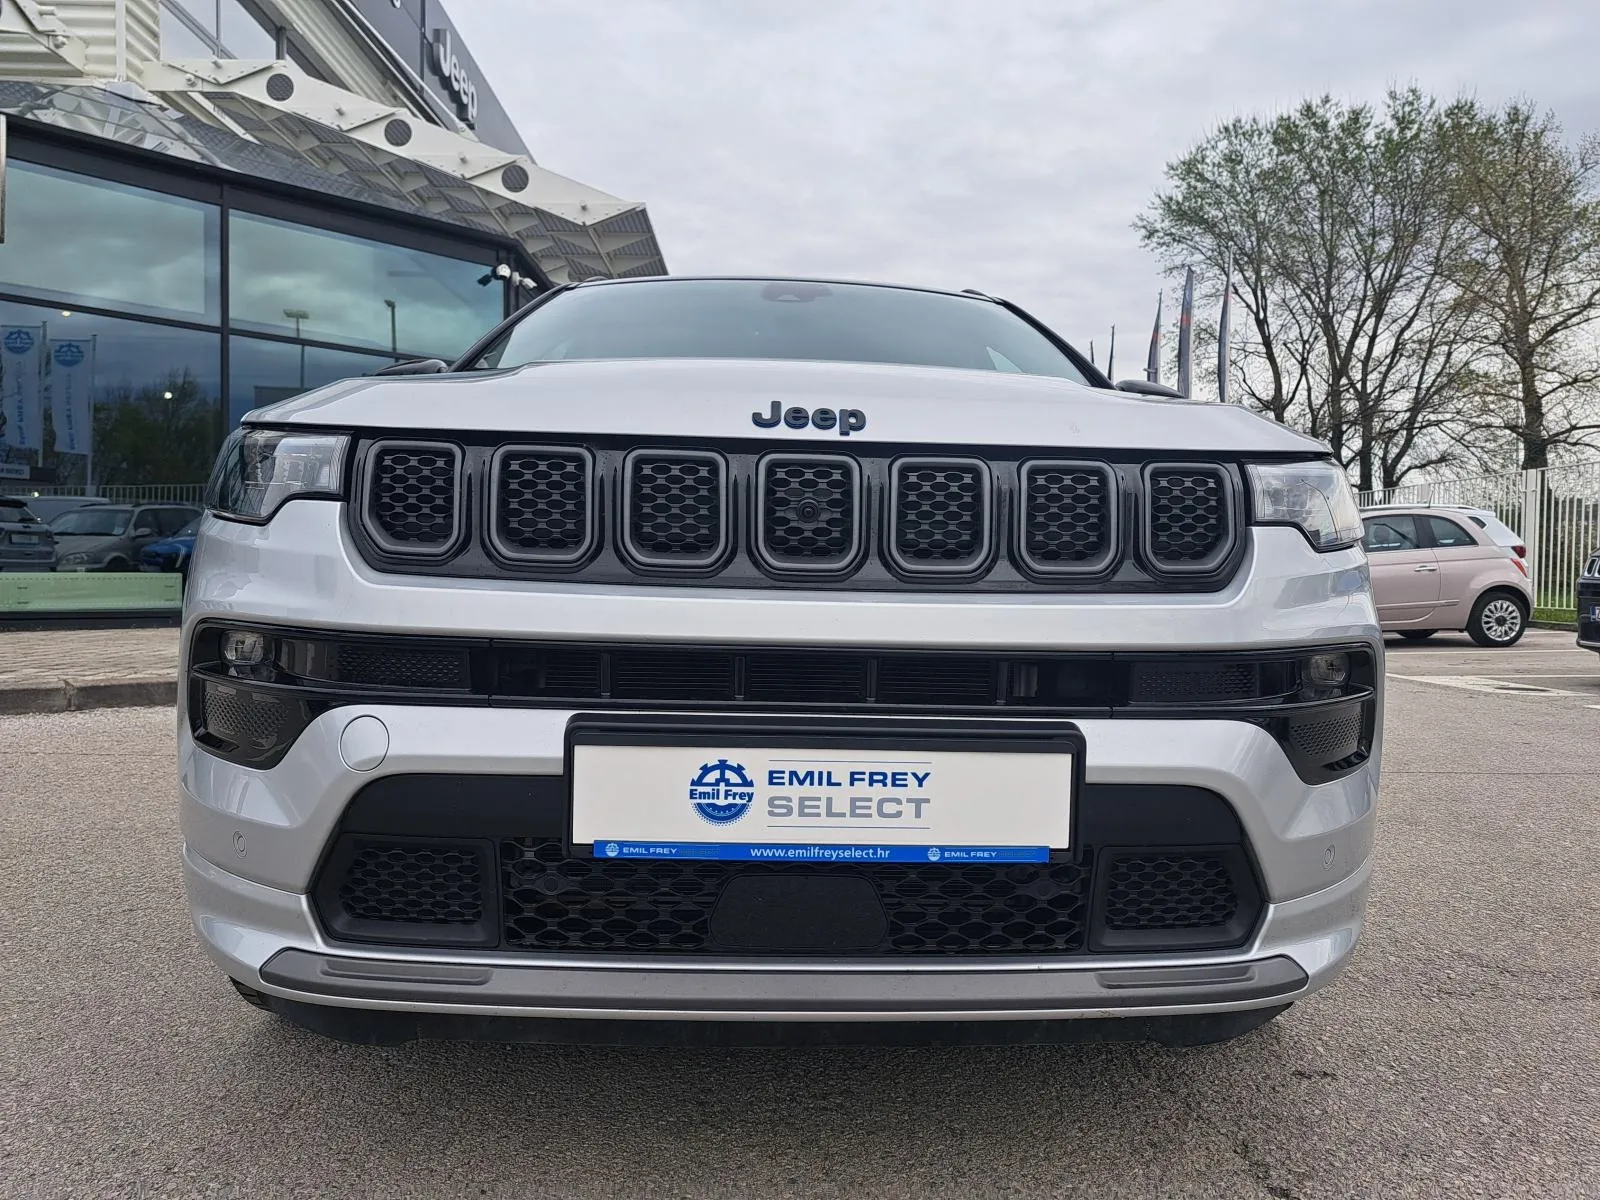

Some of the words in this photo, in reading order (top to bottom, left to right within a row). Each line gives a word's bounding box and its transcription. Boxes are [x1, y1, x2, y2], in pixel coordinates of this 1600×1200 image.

[431, 28, 477, 123] Jeep
[752, 400, 866, 436] Jeep
[767, 769, 842, 787] EMIL
[849, 771, 931, 788] FREY
[689, 788, 720, 801] Emil
[723, 789, 754, 803] Frey
[767, 796, 931, 819] SELECT
[622, 846, 648, 855] EMIL
[649, 847, 678, 855] FREY
[750, 846, 890, 861] www.emilfreyselect.hr
[944, 850, 969, 859] EMIL
[970, 850, 998, 859] FREY
